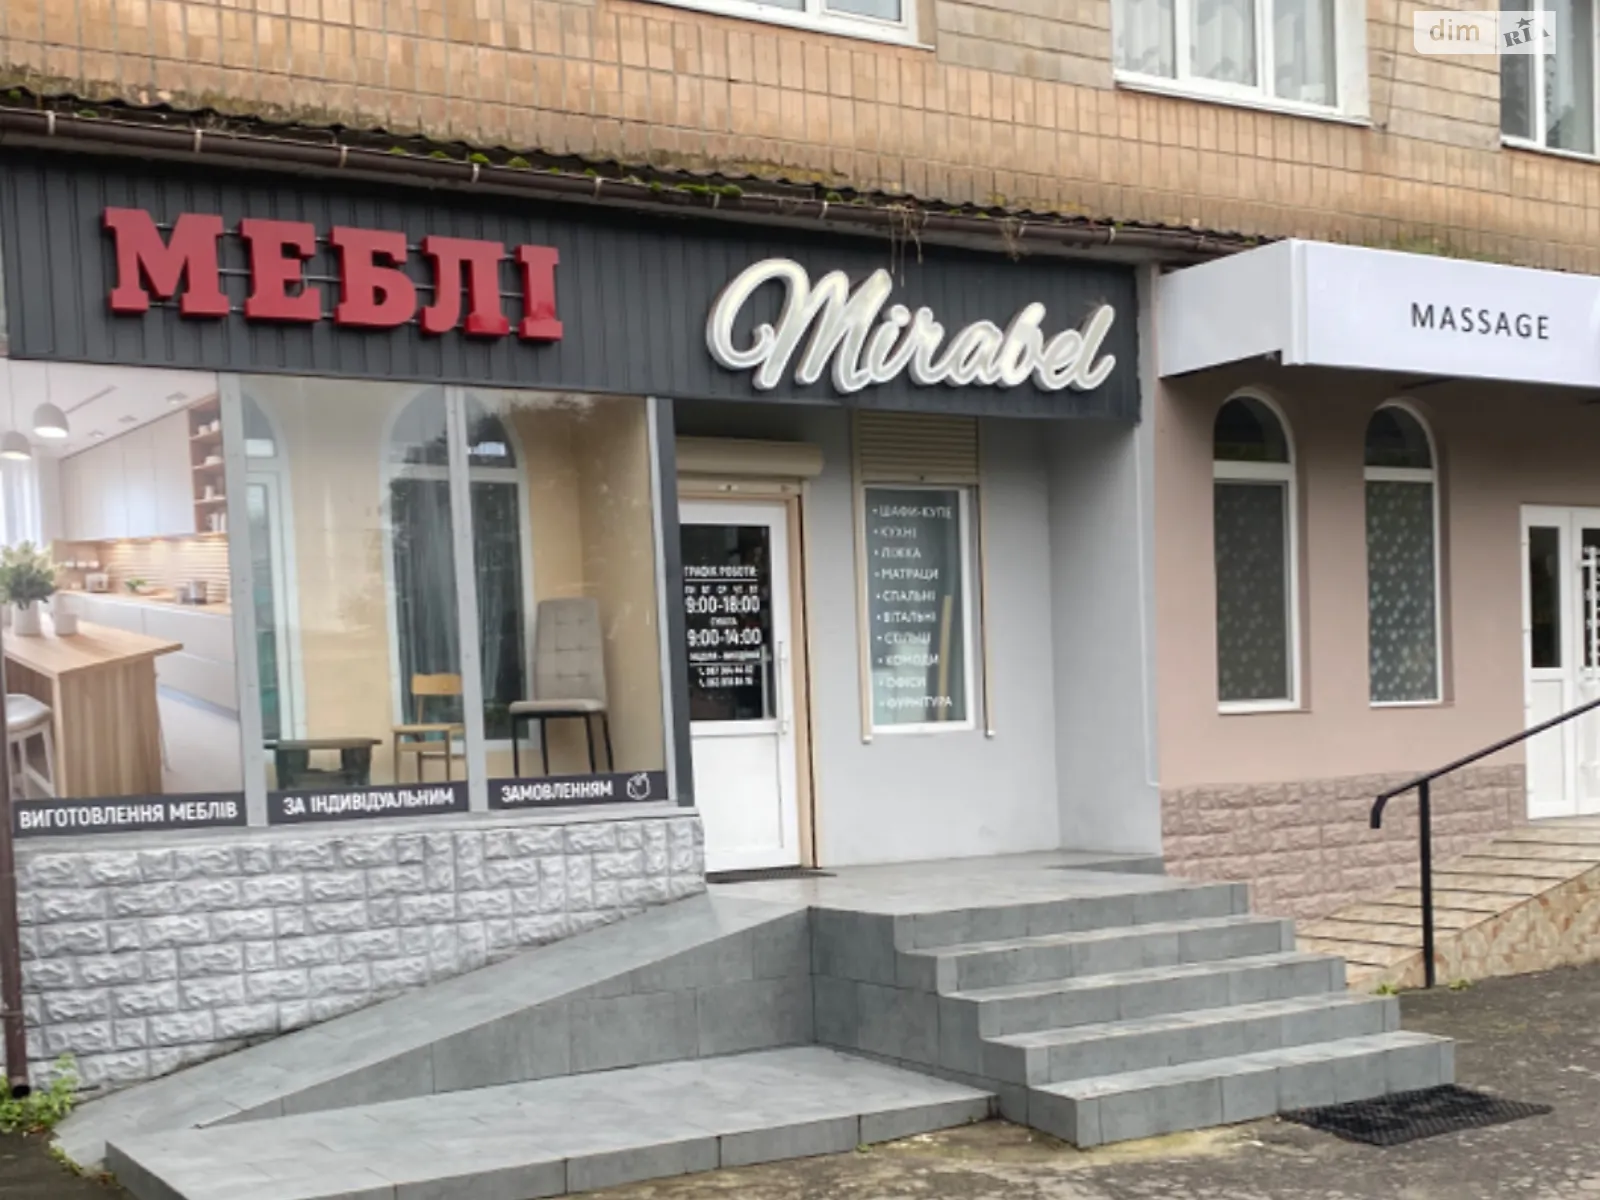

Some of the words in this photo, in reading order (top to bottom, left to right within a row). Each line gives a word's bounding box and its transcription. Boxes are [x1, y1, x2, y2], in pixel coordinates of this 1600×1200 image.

[103, 206, 564, 343] МЕБЛІ
[706, 257, 1116, 393] Mirabel
[1411, 301, 1550, 340] MASSAGE
[879, 505, 953, 519] ШАФИ-КУПЕ
[881, 526, 917, 539] КУХНІ
[881, 568, 939, 582] МАТРАЦИ
[685, 595, 760, 613] 9:00-18:00
[882, 589, 936, 602] СПАЛЬНІ
[883, 611, 936, 623] ВІТАЛЬНІ
[687, 628, 762, 647] 9:00-14:00
[502, 780, 613, 803] ЗАМОВЛЕННЯМ
[283, 796, 306, 815] ЗА
[311, 788, 454, 813] ІНДИВІДУАЛЬНИМ
[19, 804, 164, 829] ВИГОТОВЛЕННЯ
[170, 802, 238, 821] МЕБЛІВ
